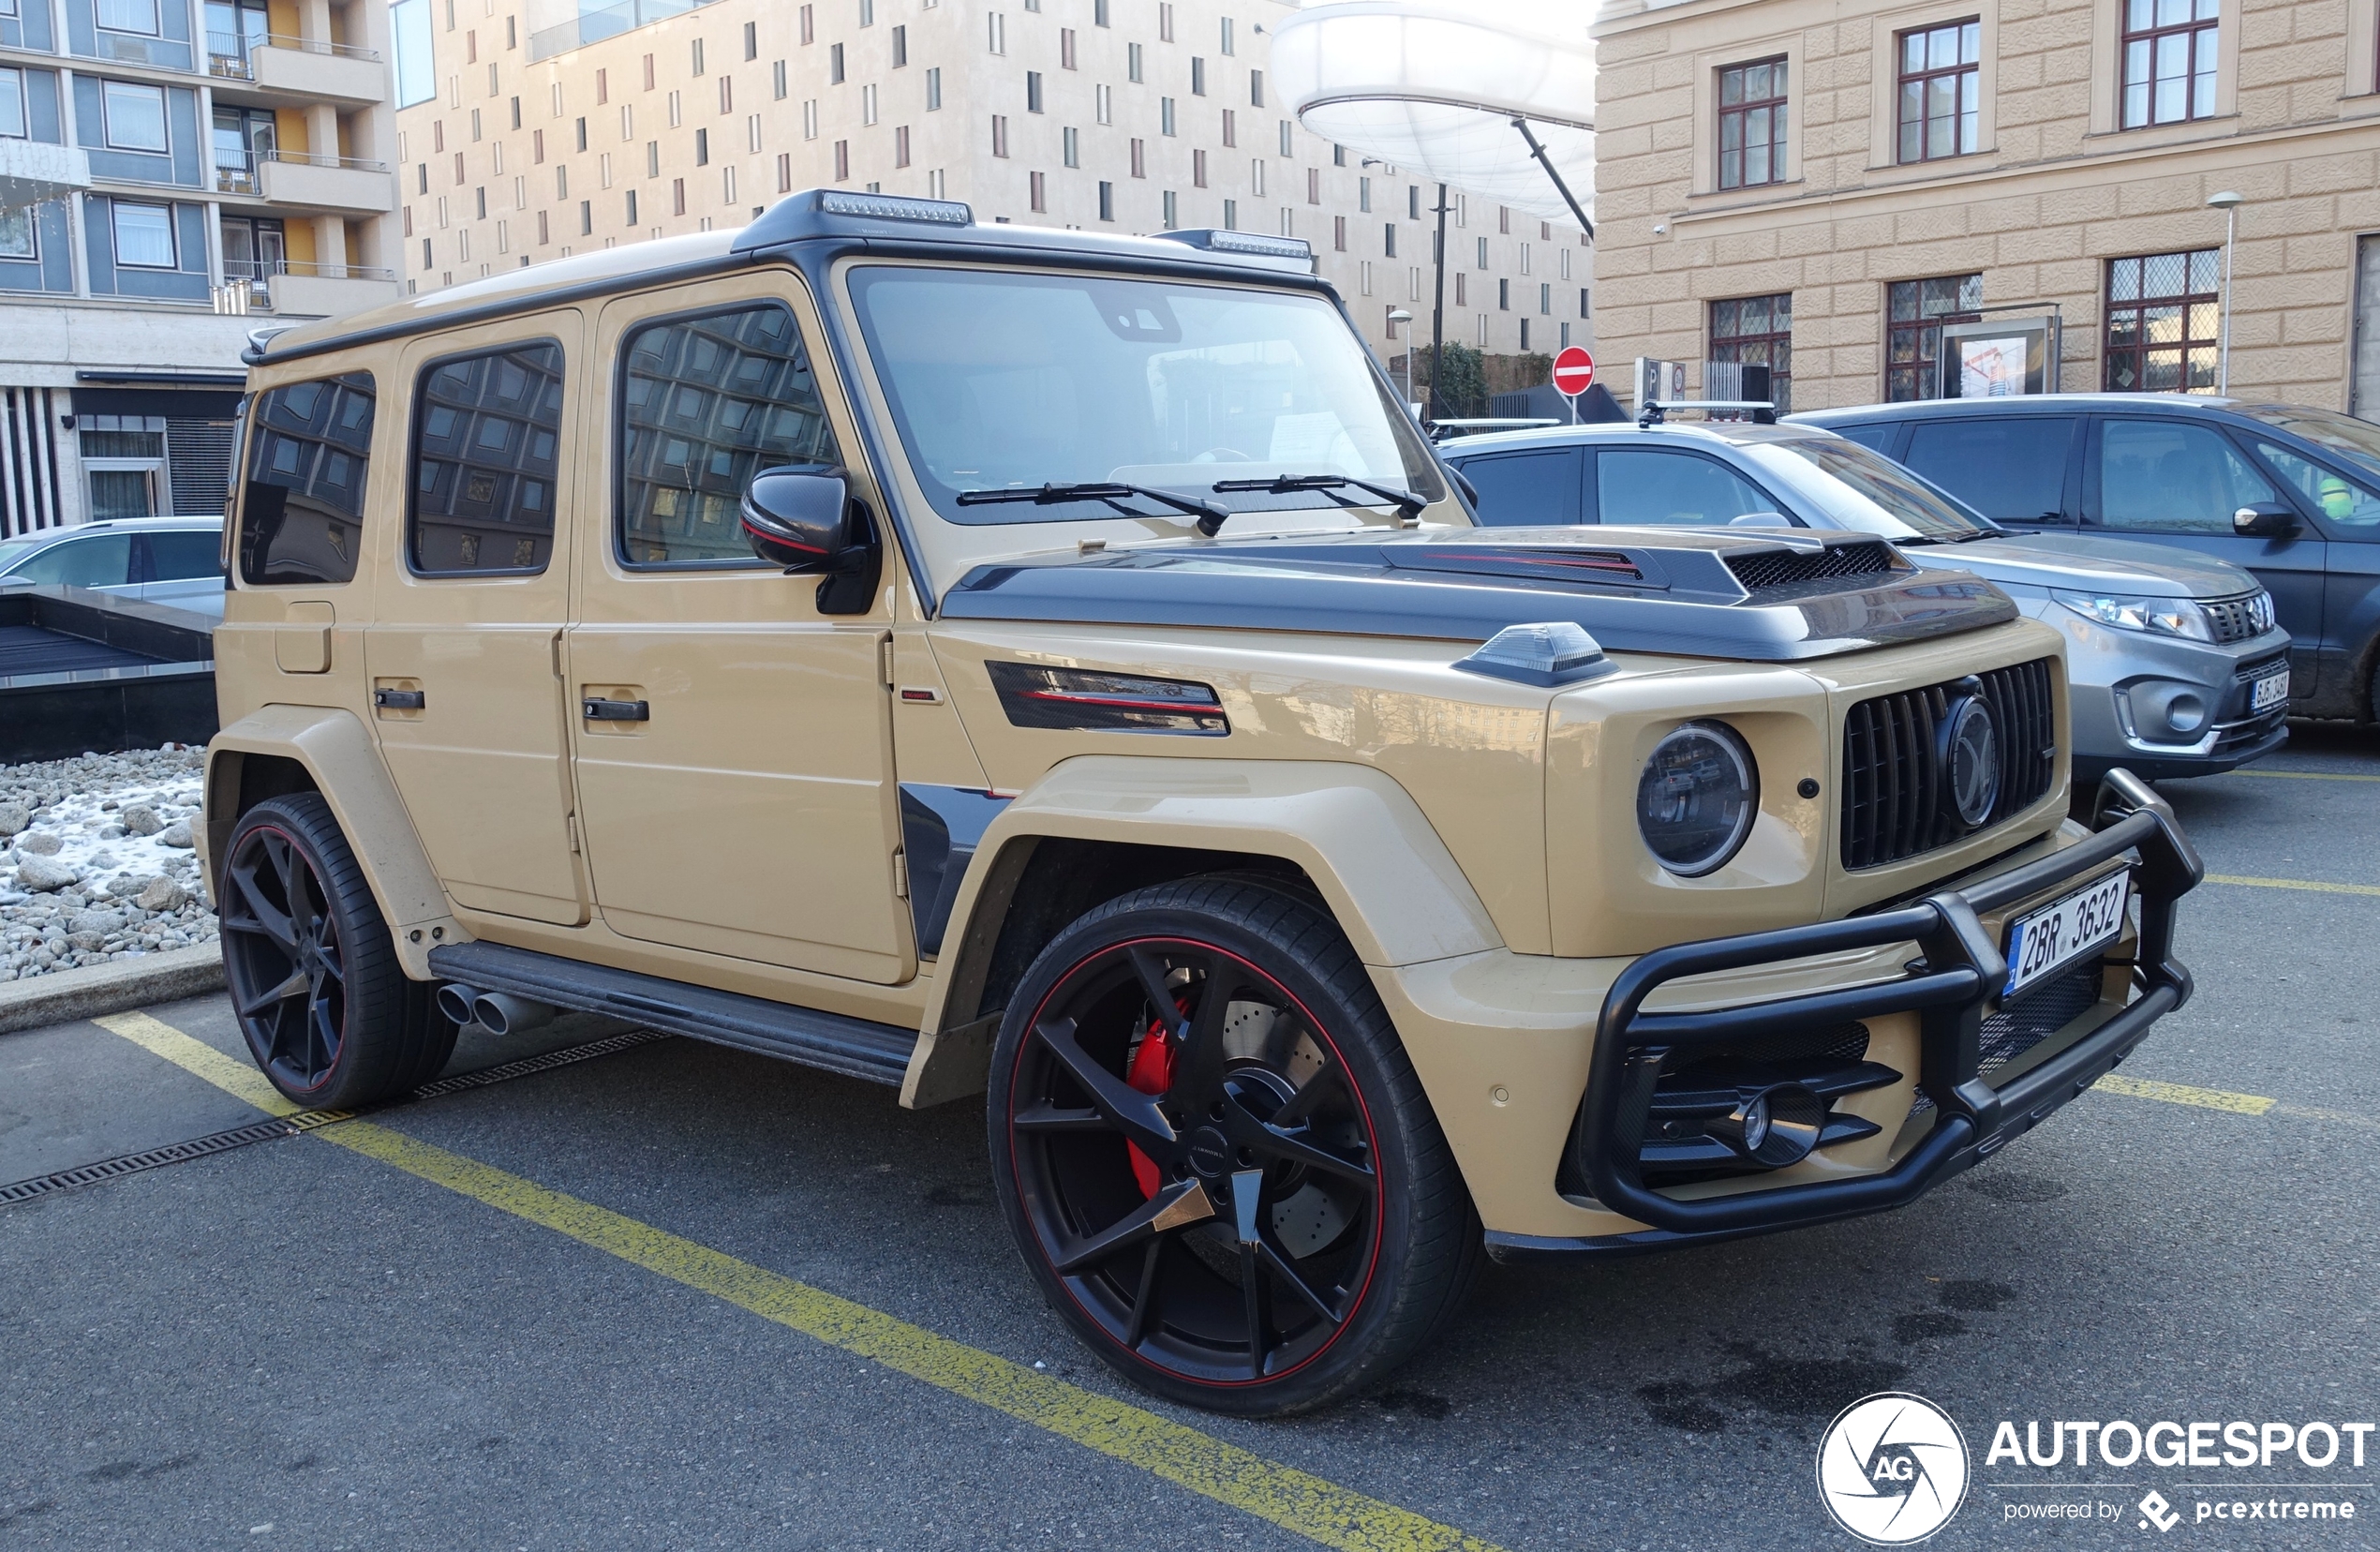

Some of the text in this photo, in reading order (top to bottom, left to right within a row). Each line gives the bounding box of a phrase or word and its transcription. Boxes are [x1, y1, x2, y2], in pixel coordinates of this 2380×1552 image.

[1650, 368, 1658, 393] P
[2021, 882, 2120, 979] 2BR 3632
